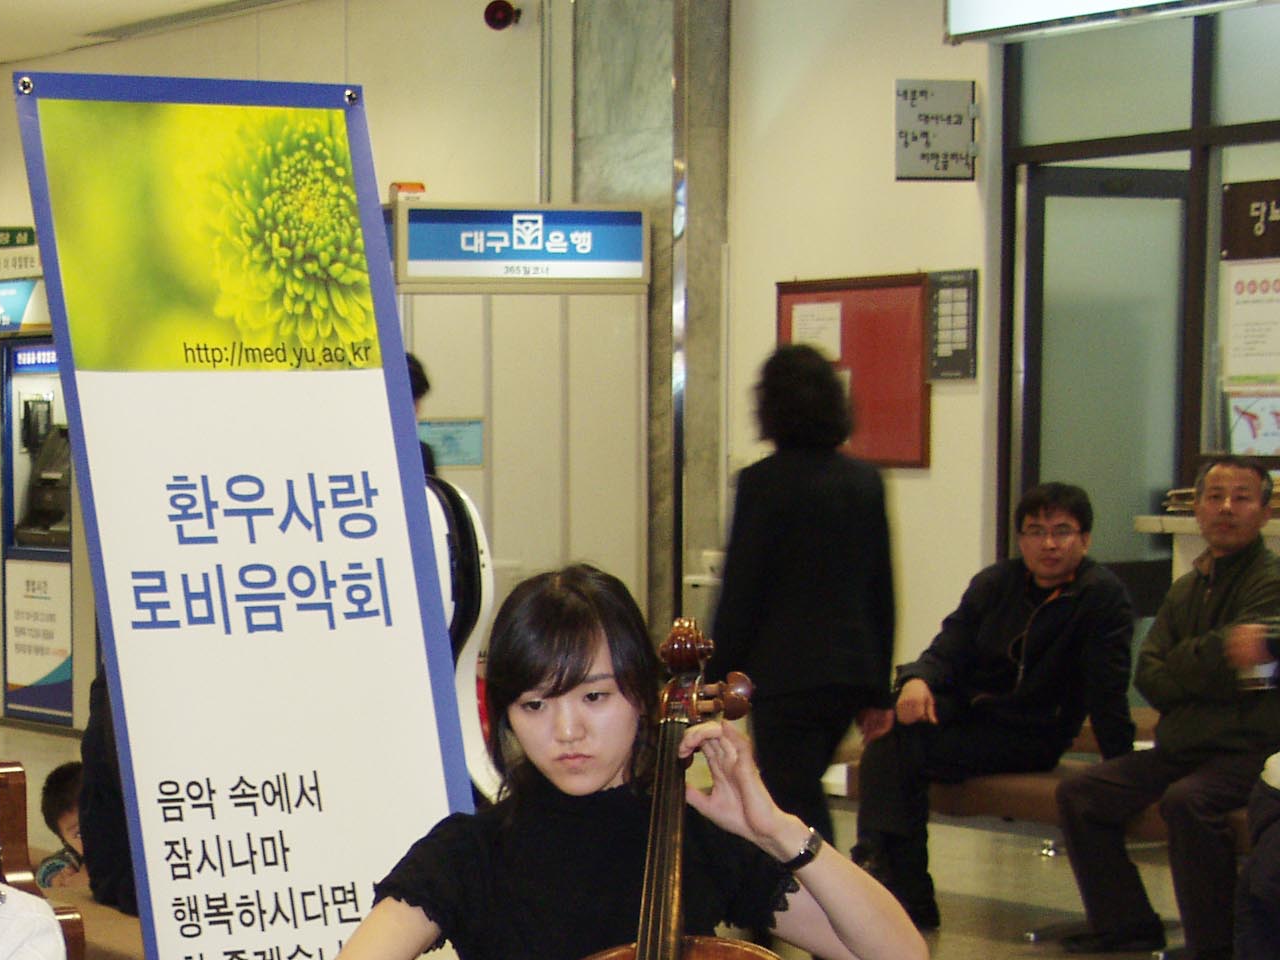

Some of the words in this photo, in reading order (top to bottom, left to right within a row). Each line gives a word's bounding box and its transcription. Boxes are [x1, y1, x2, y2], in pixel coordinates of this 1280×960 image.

[460, 230, 511, 254] 대구
[544, 230, 593, 254] 은행
[183, 341, 372, 369] http://med.yu.ac.kr
[166, 471, 379, 545] 환우사랑
[131, 557, 393, 635] 로비음악회
[156, 777, 217, 823] 음악
[228, 770, 323, 817] 속에서
[164, 829, 290, 881] 잠시나마
[172, 881, 362, 939] 행복하시다면
